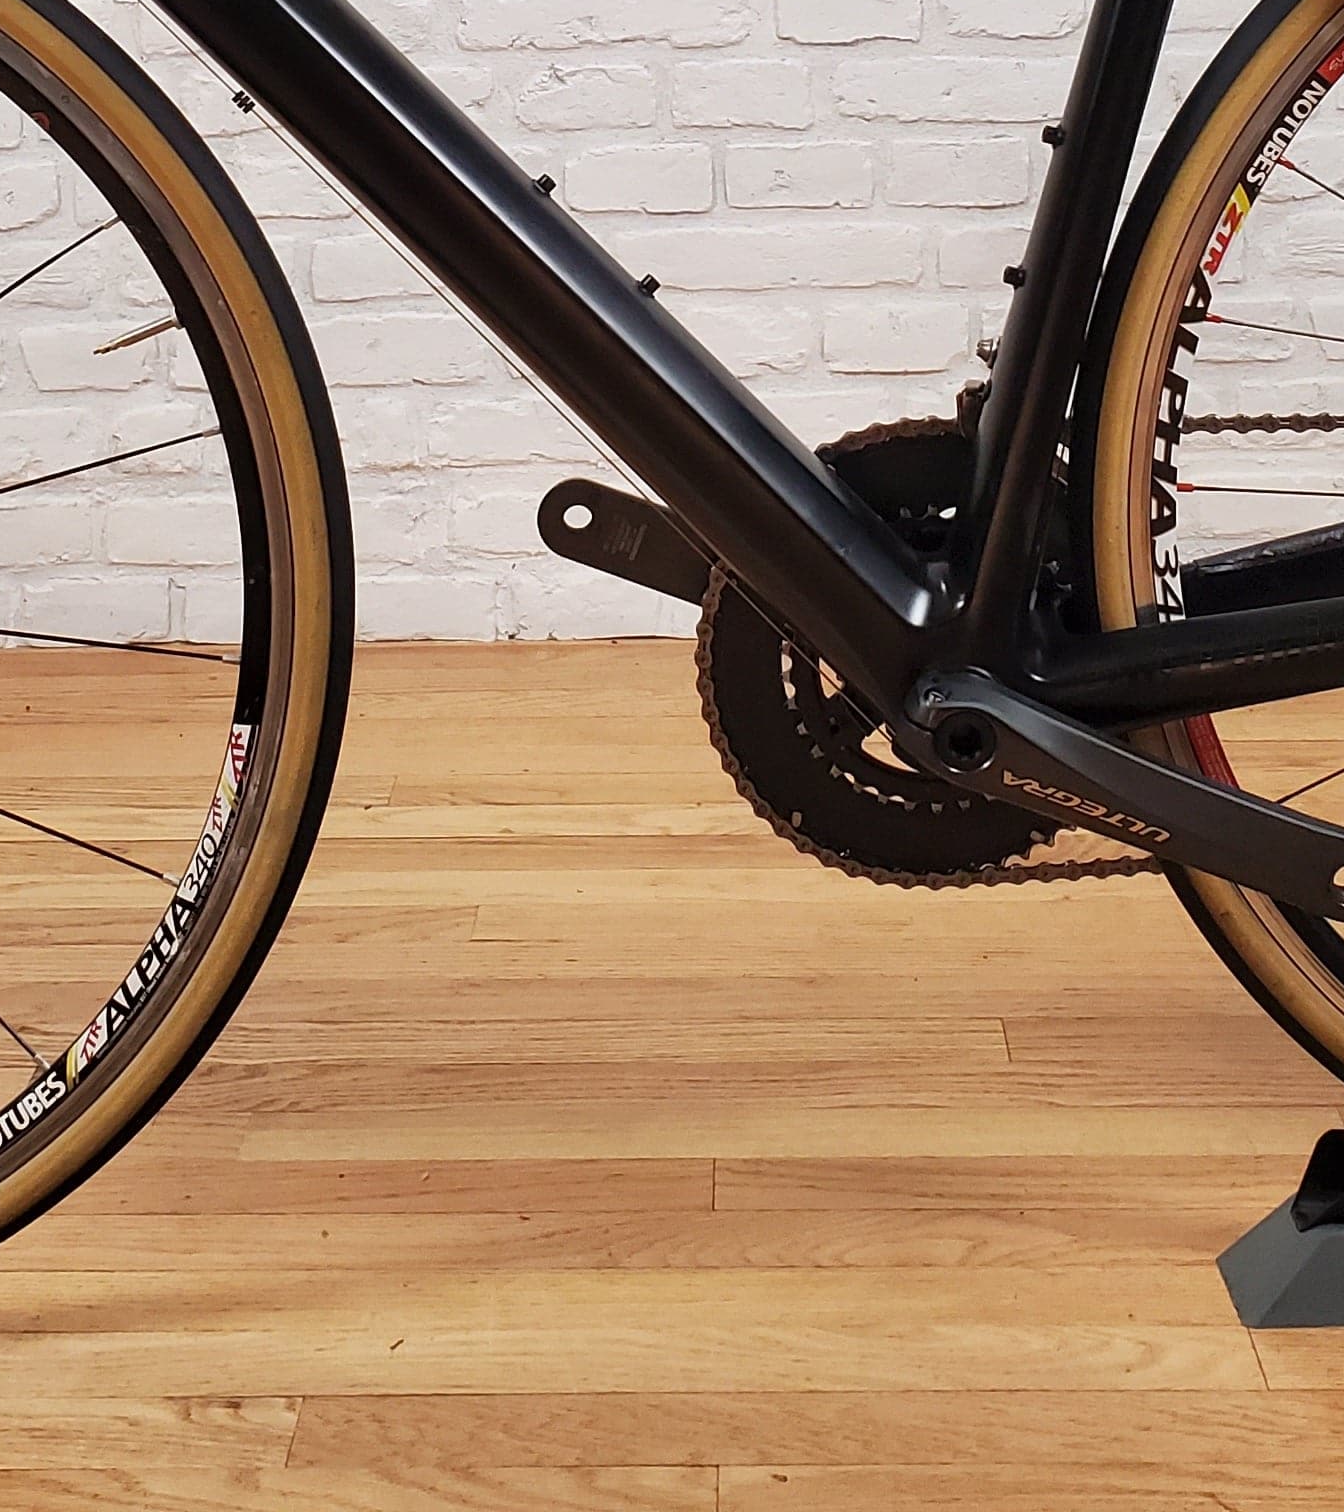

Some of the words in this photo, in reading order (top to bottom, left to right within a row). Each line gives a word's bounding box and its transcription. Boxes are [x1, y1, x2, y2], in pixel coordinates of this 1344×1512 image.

[1246, 80, 1325, 187] NOTUBES
[1204, 201, 1244, 273] ZTR
[1149, 266, 1212, 549] ALPHA
[1152, 544, 1182, 622] 34
[1002, 769, 1171, 843] ULTEGRA
[80, 1021, 101, 1063] ZTR
[103, 894, 199, 1038] ALPHA
[183, 833, 216, 896] 340
[211, 794, 222, 833] ZTR
